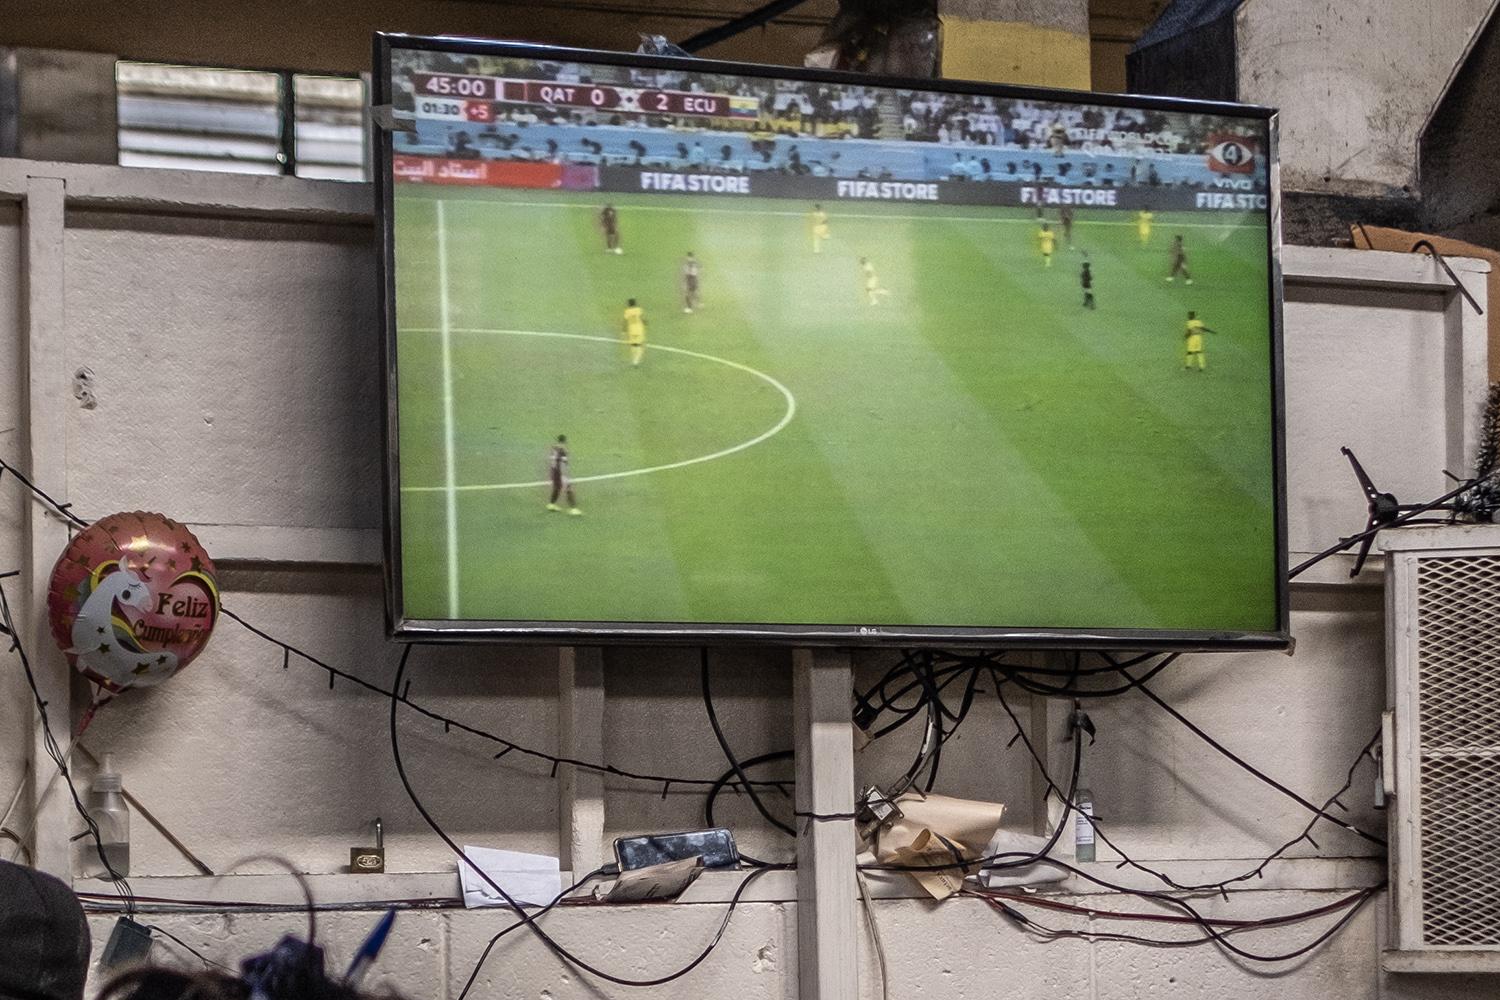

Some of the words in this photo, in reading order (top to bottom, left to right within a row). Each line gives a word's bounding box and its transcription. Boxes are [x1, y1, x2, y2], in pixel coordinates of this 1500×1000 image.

[425, 77, 486, 97] 45:00
[540, 86, 575, 104] QAT
[590, 89, 605, 106] 0
[422, 102, 460, 116] 01:30
[469, 104, 489, 119] +5
[655, 93, 669, 111] 2
[683, 97, 717, 114] ECU
[154, 592, 209, 618] Feliz
